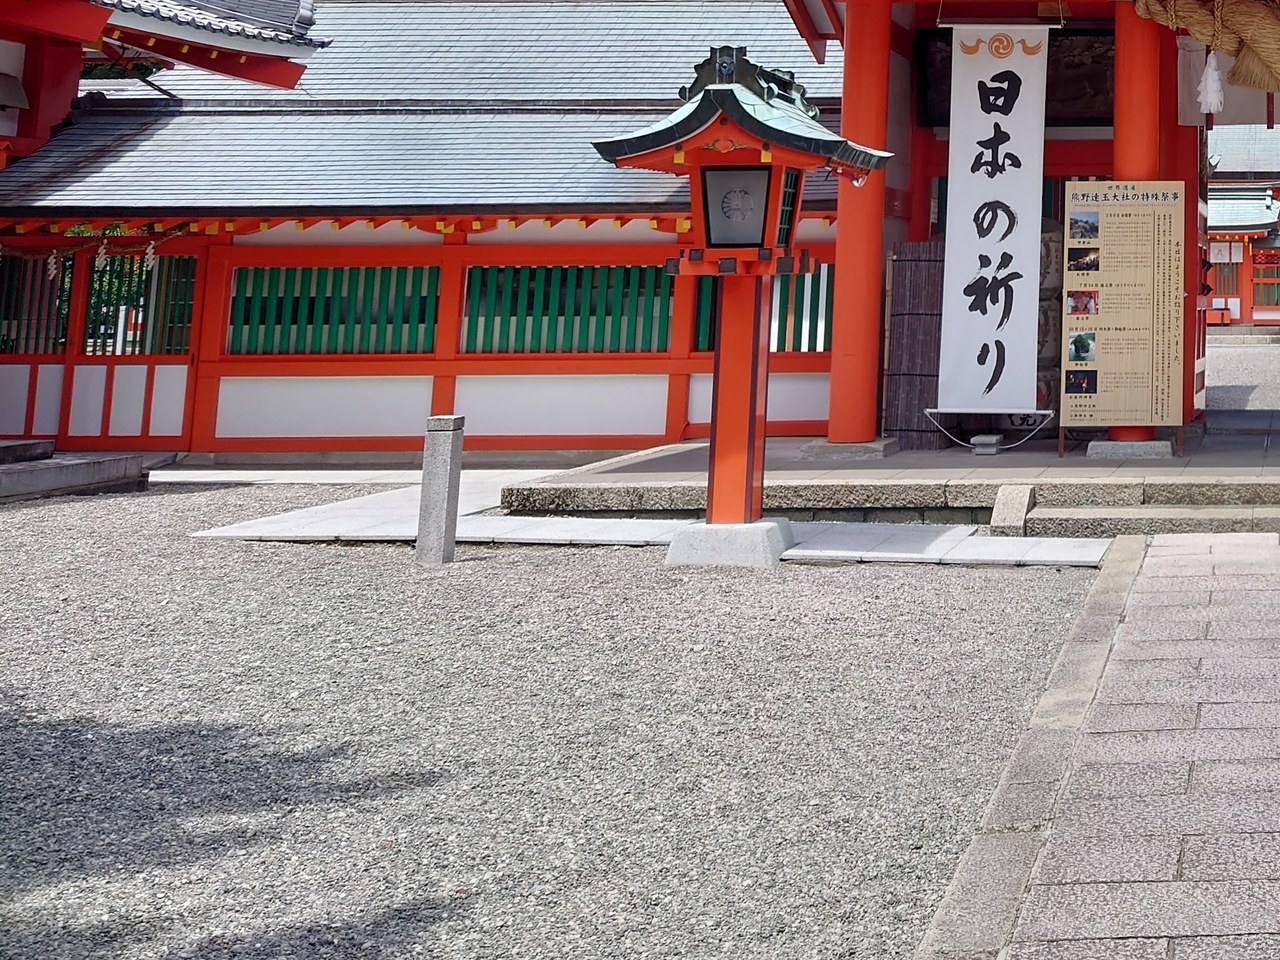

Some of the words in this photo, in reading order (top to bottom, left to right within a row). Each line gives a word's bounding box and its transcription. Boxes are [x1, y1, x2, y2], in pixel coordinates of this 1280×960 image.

[963, 69, 1024, 399] 日本の祈り
